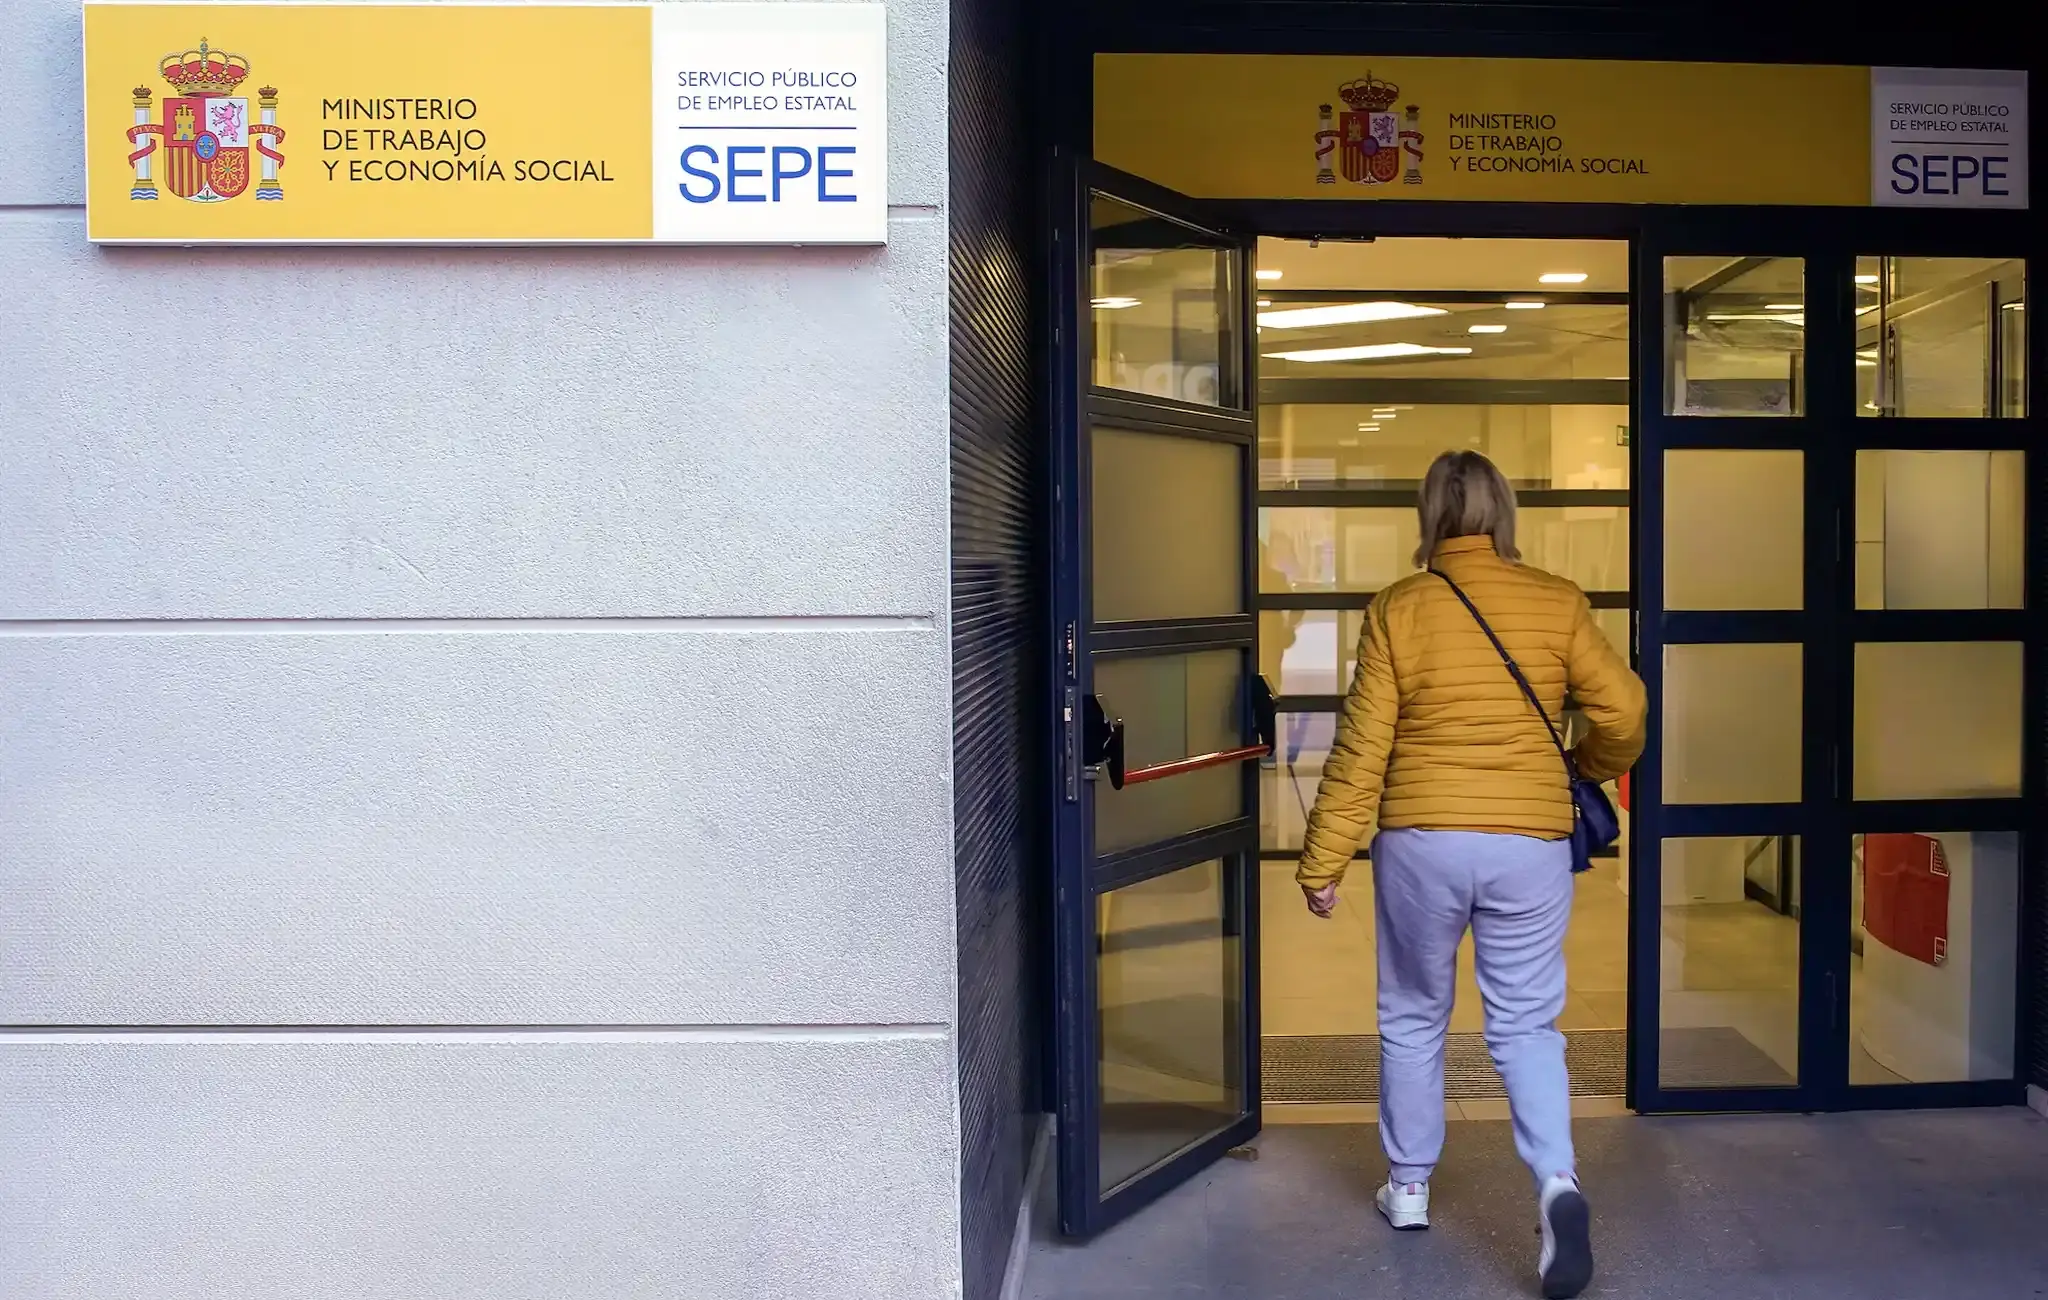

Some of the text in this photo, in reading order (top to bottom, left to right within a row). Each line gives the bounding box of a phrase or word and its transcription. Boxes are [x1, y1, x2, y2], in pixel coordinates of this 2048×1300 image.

[677, 67, 857, 88] SERVICIO PÚBLICO
[322, 98, 477, 120] MINISTERIO
[678, 95, 857, 111] DE EMPLEO ESTATAL
[1890, 102, 2010, 117] SERVICIO PÚBLICO
[1449, 112, 1557, 130] MINISTERIO
[1890, 119, 2010, 133] DE EMPLEO ESTATAL
[323, 129, 487, 158] DE TRABAJO
[1449, 134, 1563, 156] DE TRABAJO
[322, 154, 615, 182] Y ECONOMÍA SOCIAL
[679, 145, 858, 203] SEPE
[1449, 153, 1650, 175] Y ECONOMÍA SOCIAL
[1891, 153, 2009, 195] SEPE
